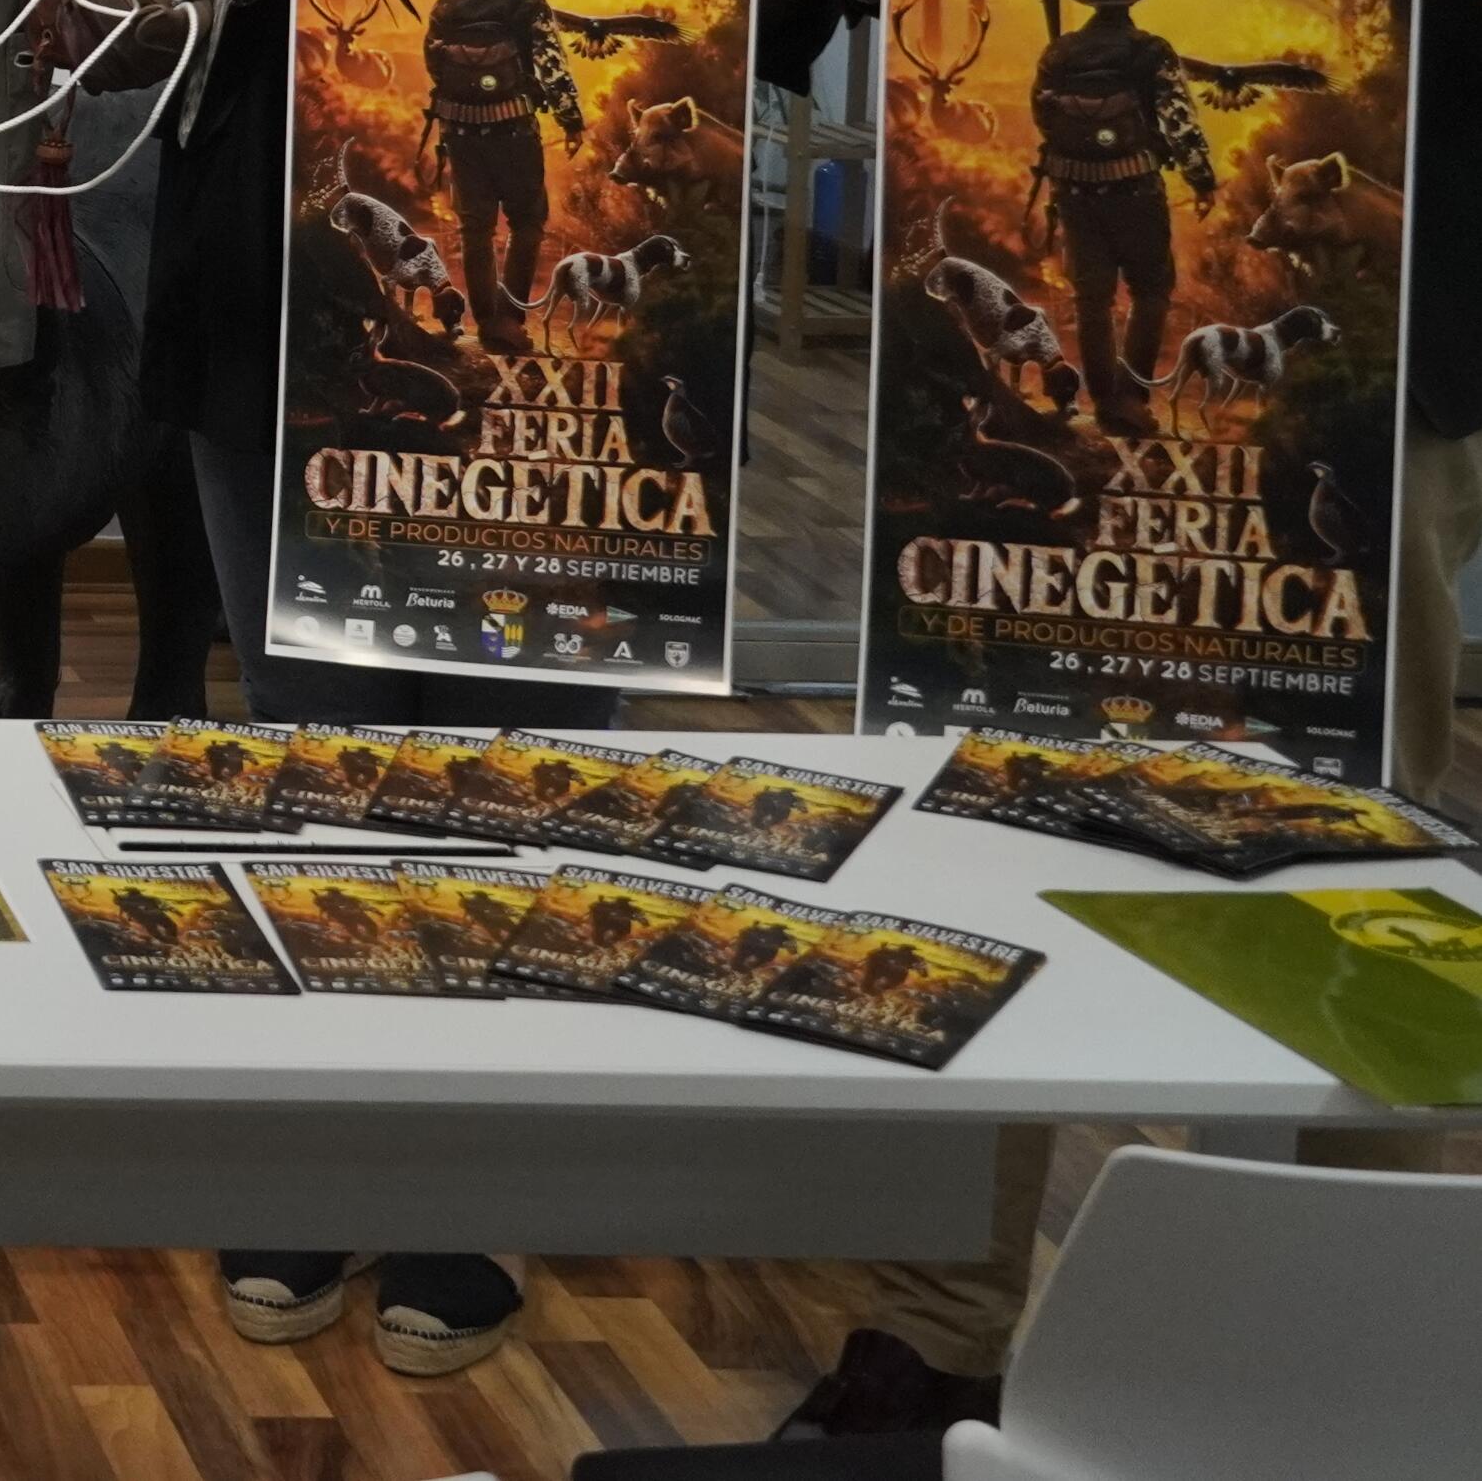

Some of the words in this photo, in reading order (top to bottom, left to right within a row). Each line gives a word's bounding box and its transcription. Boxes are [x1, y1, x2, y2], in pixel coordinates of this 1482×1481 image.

[483, 353, 625, 412] XXII
[475, 407, 636, 465] FERIA
[1098, 435, 1266, 502] XXII
[304, 445, 718, 538] CINEGÉTICA
[325, 516, 340, 535] Y
[347, 519, 381, 540] DE
[389, 521, 546, 551] PRODUCTOS
[554, 533, 703, 561] NATURALES
[1094, 495, 1277, 561] FERIA
[482, 552, 508, 570] 27
[514, 555, 528, 572] Y
[533, 556, 560, 574] 28
[566, 559, 701, 586] SEPTIEMBRE
[897, 534, 1373, 642] CINEGÉTICA
[558, 604, 589, 617] EDIA
[921, 615, 939, 633] Y
[947, 614, 985, 638] DE
[994, 617, 1176, 653] PRODUCTOS
[1184, 632, 1358, 669] NATURALES
[1100, 654, 1131, 675] 27
[1138, 659, 1154, 677] Y
[1160, 660, 1192, 680] 28
[1197, 663, 1354, 695] SEPTIEMBRE
[42, 723, 84, 735] SAN
[177, 717, 220, 730] SAN
[305, 721, 348, 736] SAN
[1189, 713, 1223, 728] EDIA
[415, 730, 459, 746] SAN
[507, 730, 551, 749] SAN
[978, 726, 1023, 743] SAN
[735, 757, 782, 776] SAN
[782, 768, 889, 798] SILVESTRE
[51, 860, 98, 876] SAN
[102, 863, 215, 880] SILVESTRE
[251, 863, 299, 878] SAN
[401, 862, 448, 878] SAN
[562, 866, 611, 883] SAN
[723, 885, 775, 910] SAN
[850, 912, 902, 932] SAN
[903, 922, 1026, 963] SILVESTRE
